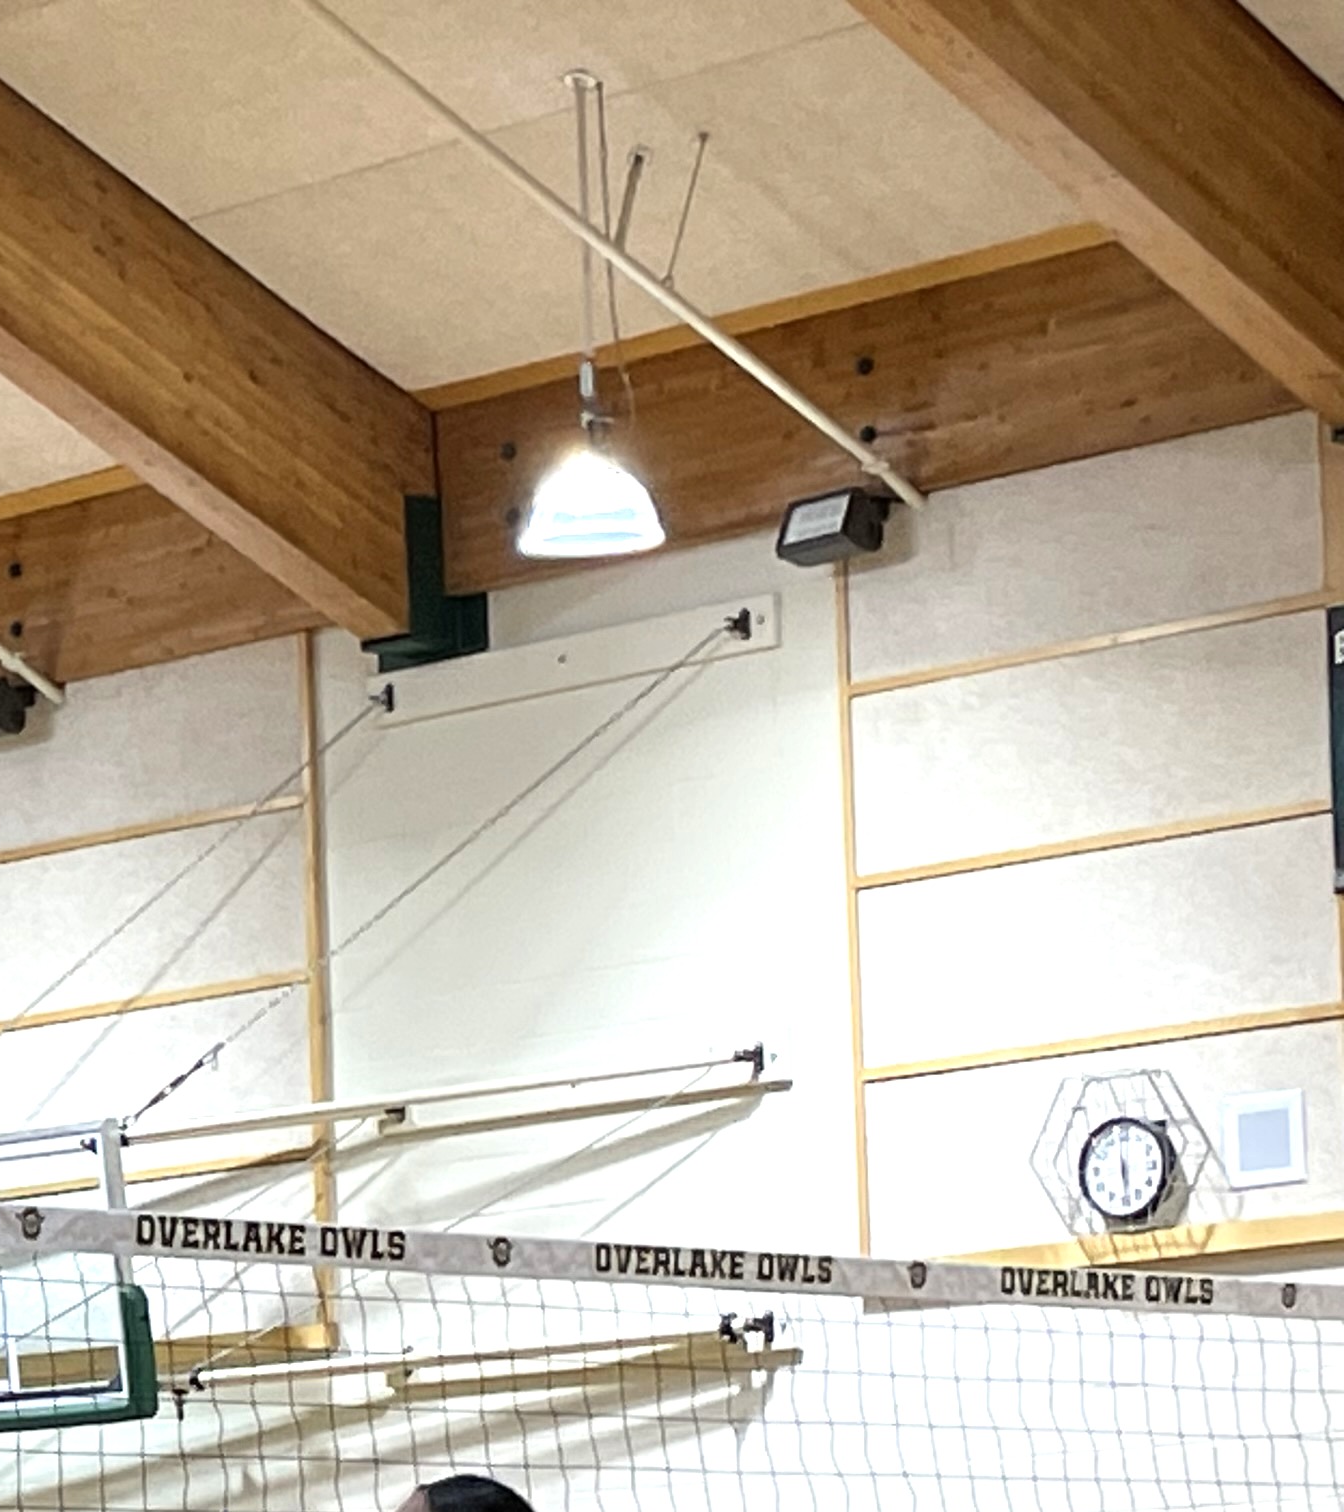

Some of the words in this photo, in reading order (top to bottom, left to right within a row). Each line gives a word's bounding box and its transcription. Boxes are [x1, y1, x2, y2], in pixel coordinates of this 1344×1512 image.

[136, 1214, 306, 1255] OVERLAKE
[320, 1226, 407, 1261] OWLS
[594, 1242, 744, 1281] OVERLAKE
[757, 1253, 833, 1284] OWLS
[1000, 1267, 1135, 1302] OVERLAKE
[1145, 1276, 1213, 1304] OWLS
